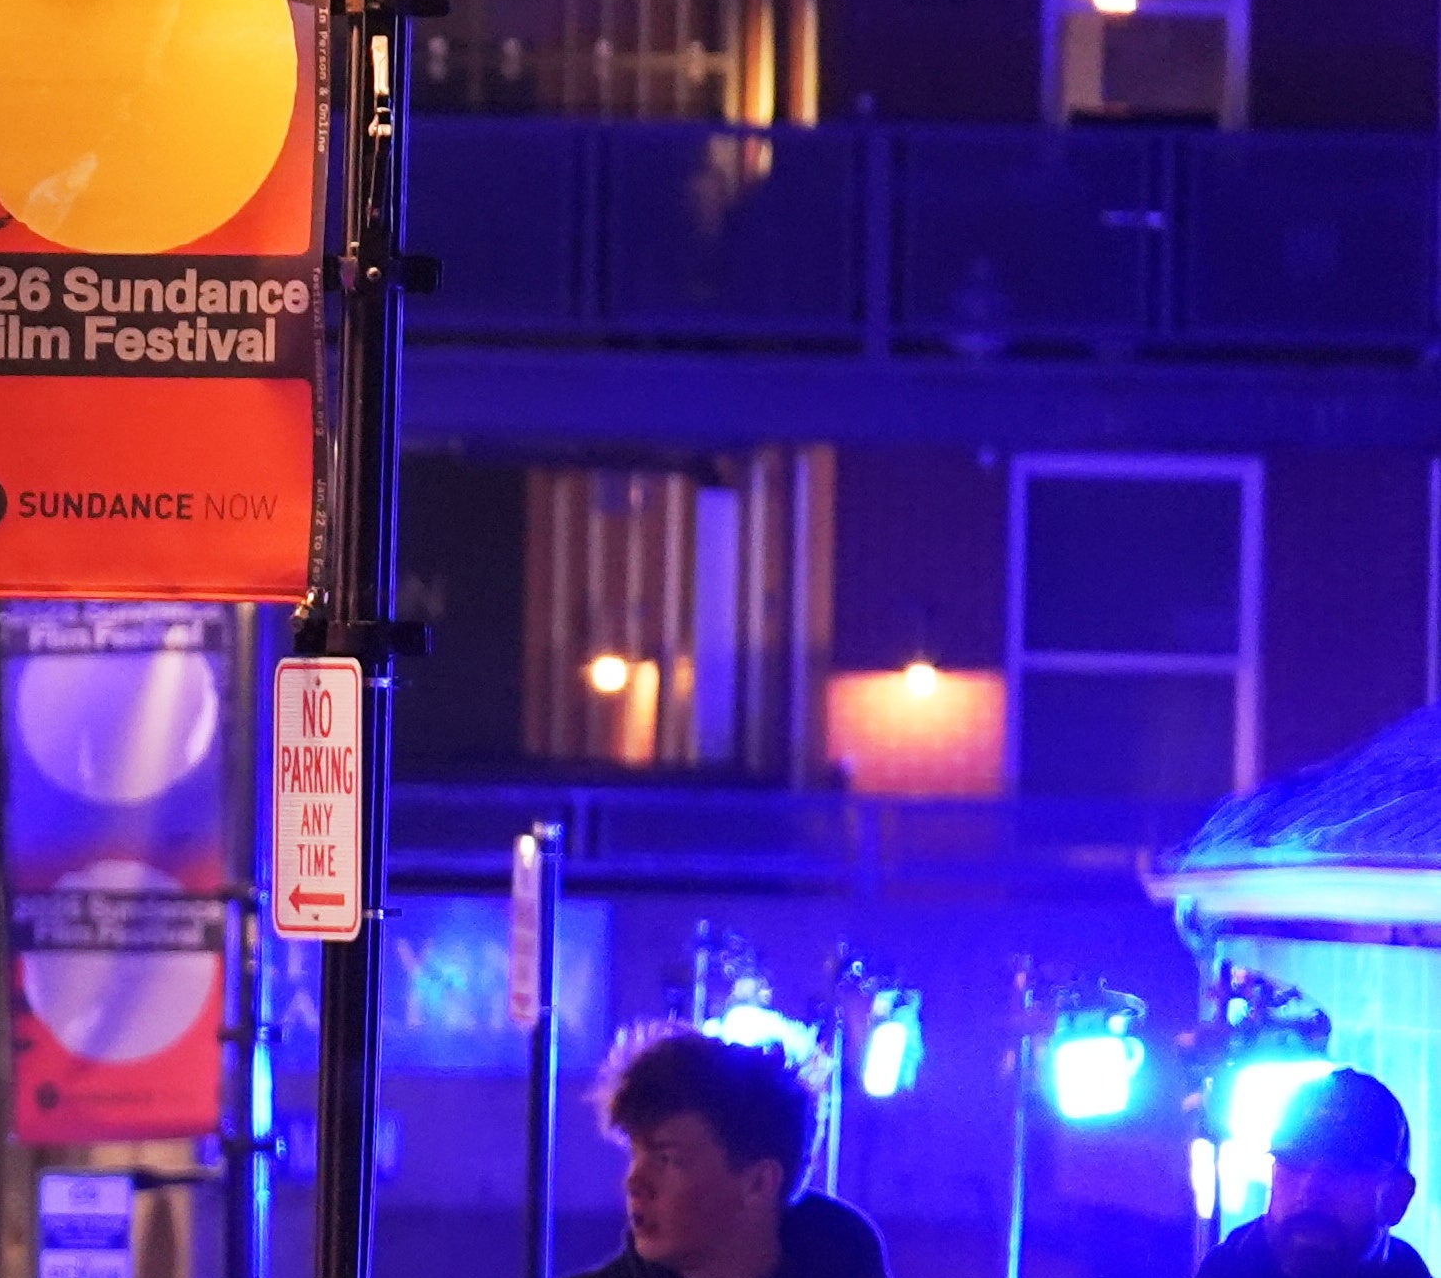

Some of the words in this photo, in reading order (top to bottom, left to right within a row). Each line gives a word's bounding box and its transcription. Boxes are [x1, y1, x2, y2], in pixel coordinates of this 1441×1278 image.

[318, 30, 328, 80] Person
[317, 102, 329, 152] Online
[63, 267, 310, 315] Sundance
[84, 316, 276, 362] Festival
[19, 490, 194, 520] SUNDANCE
[204, 493, 278, 521] NOW
[302, 689, 333, 738] NO
[281, 745, 353, 795] PARKING
[300, 802, 334, 837] ANY
[297, 844, 337, 878] TIME
